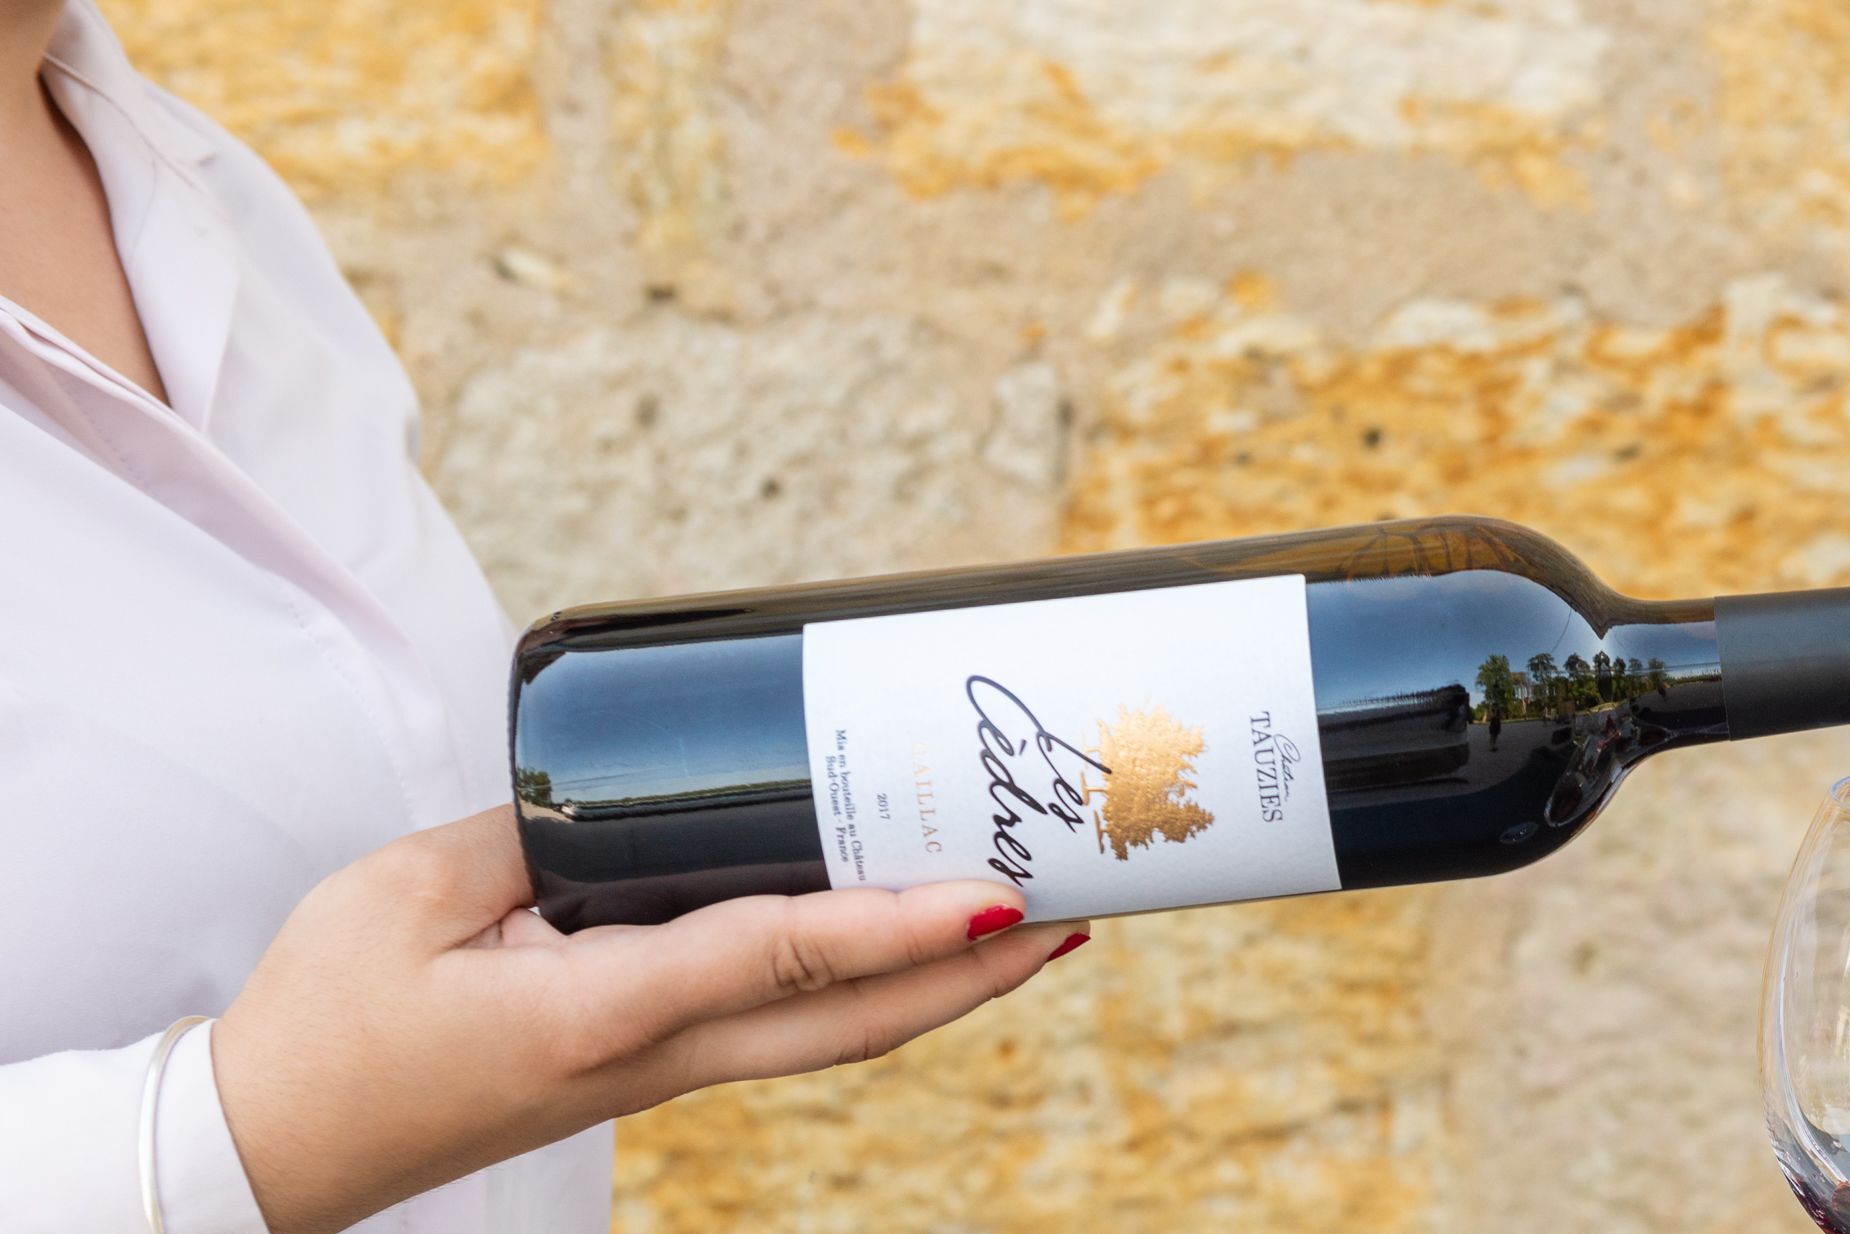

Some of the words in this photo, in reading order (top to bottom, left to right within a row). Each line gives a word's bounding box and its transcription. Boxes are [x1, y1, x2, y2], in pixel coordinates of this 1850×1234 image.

[836, 729, 847, 751] Mis
[838, 754, 846, 768] en
[1249, 710, 1283, 822] TAUZIES
[840, 771, 856, 821] bouteille
[966, 675, 1049, 887] Cèdres
[1036, 730, 1112, 833] Les
[876, 793, 890, 820] 2017
[836, 826, 849, 863] France
[848, 823, 857, 837] au
